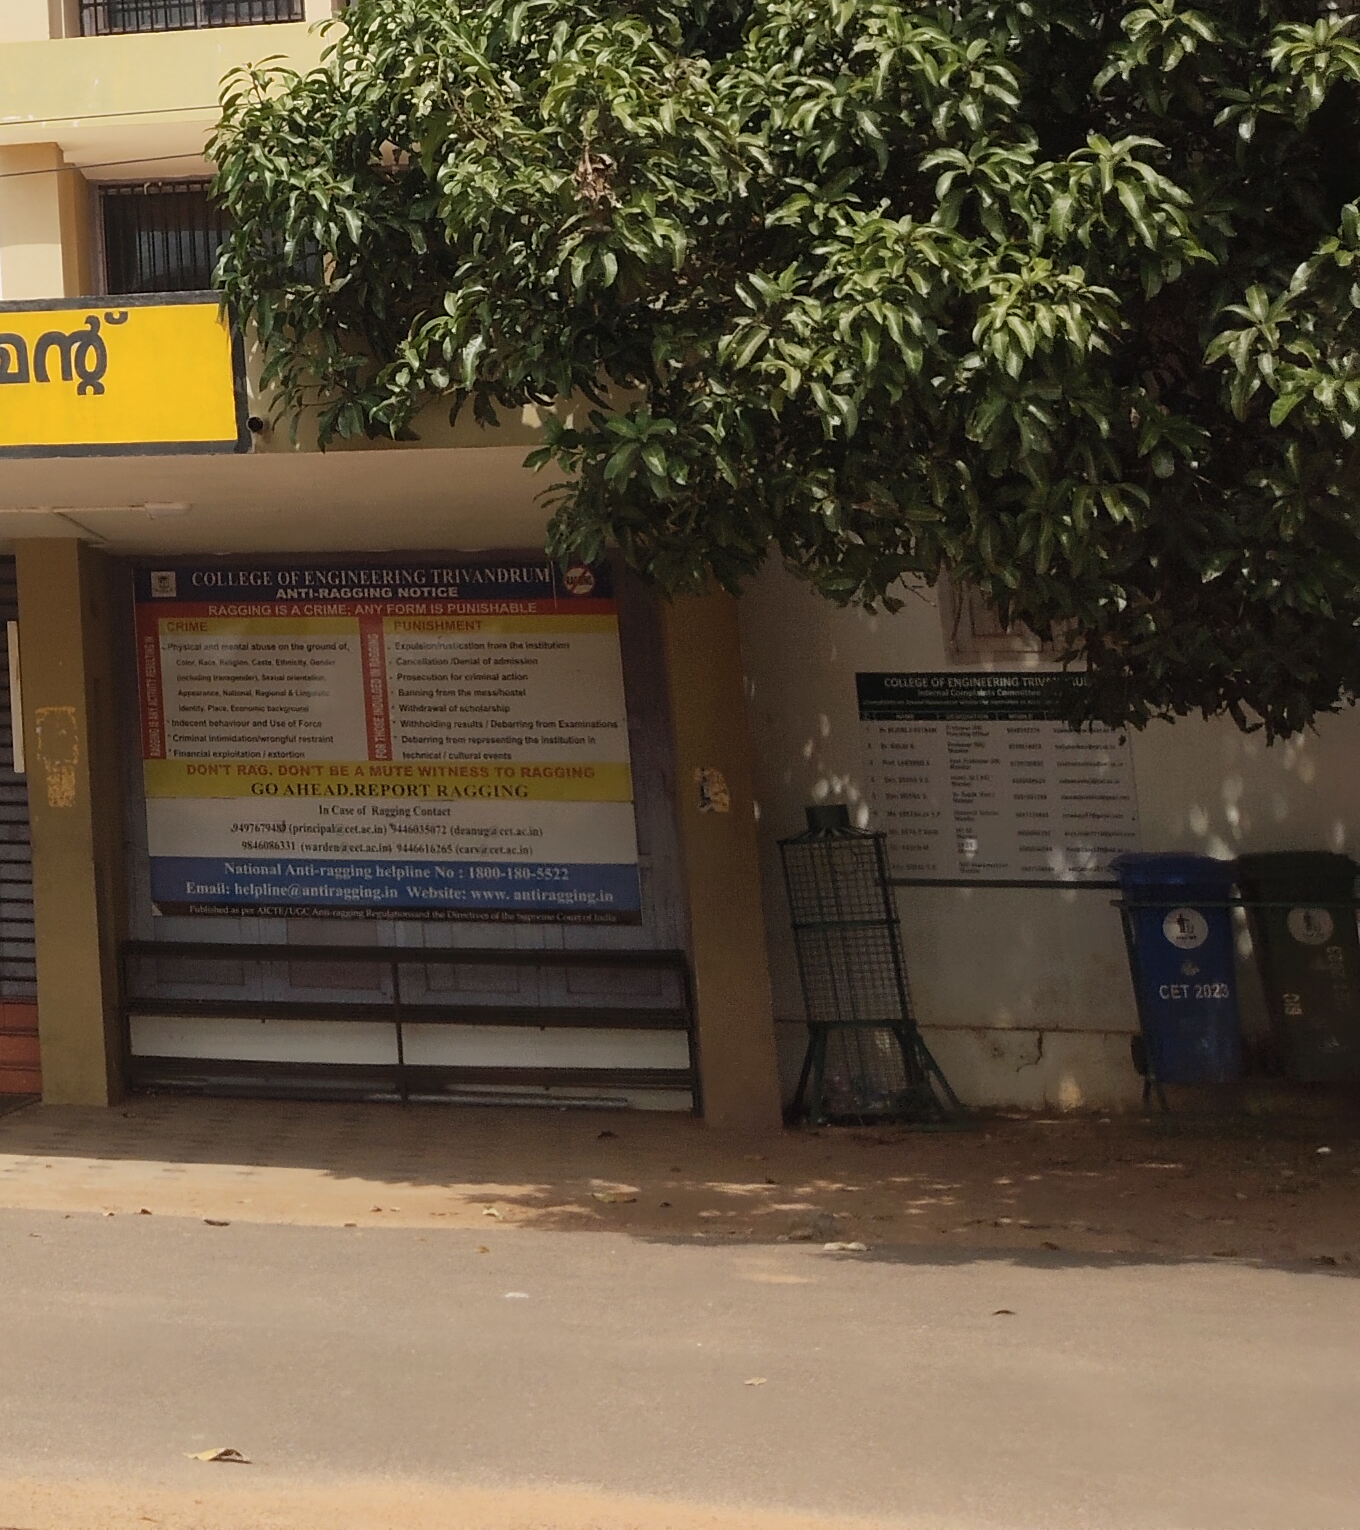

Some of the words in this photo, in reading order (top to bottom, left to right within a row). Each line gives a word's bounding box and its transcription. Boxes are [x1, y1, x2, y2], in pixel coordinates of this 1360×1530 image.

[192, 571, 273, 586] COLLEGE
[278, 571, 299, 585] OF
[306, 570, 426, 584] ENGINEERING
[430, 568, 551, 584] TRIVANDRUM
[276, 588, 393, 598] ANTI-RAGGING
[398, 587, 458, 598] NOTICE
[208, 605, 271, 616] RAGGING
[275, 605, 287, 615] IS
[291, 605, 301, 615] A
[355, 604, 383, 614] ANY
[387, 604, 426, 614] FORM
[430, 604, 443, 614] IS
[447, 602, 537, 614] PUNISHABLE
[166, 622, 207, 632] CRIME
[394, 621, 482, 631] PUNISHMENT
[168, 643, 201, 651] Physical
[221, 643, 249, 651] mental
[251, 643, 276, 651] abuse
[278, 643, 289, 651] on
[291, 643, 304, 651] the
[306, 643, 336, 651] ground
[487, 642, 507, 651] from
[509, 642, 523, 651] the
[396, 657, 449, 665] Cancellation
[483, 657, 491, 665] of
[493, 657, 538, 665] admission
[261, 674, 284, 682] Sexual
[397, 673, 448, 681] Prosecution
[450, 673, 462, 681] for
[465, 673, 499, 681] criminal
[502, 673, 528, 681] action
[884, 678, 929, 687] COLLEGE
[931, 678, 946, 687] OF
[948, 678, 1019, 687] ENGINEERING
[399, 689, 433, 698] Banning
[436, 689, 455, 698] from
[458, 689, 472, 698] the
[231, 705, 265, 713] Economic
[267, 705, 308, 713] background
[399, 704, 446, 713] Withdrawal
[449, 704, 457, 713] of
[460, 704, 510, 713] scholarship
[172, 720, 206, 728] Indecent
[209, 720, 250, 728] behaviour
[252, 720, 267, 728] and
[270, 720, 285, 728] Use
[288, 720, 296, 728] of
[298, 720, 321, 728] Force
[400, 720, 451, 729] Withholding
[454, 720, 483, 729] results
[490, 720, 533, 729] Debarring
[536, 720, 556, 729] from
[558, 720, 618, 729] Examinations
[173, 734, 206, 744] Criminal
[298, 734, 333, 744] restraint
[401, 736, 443, 745] Debarring
[446, 736, 465, 745] from
[468, 736, 522, 745] representing
[525, 736, 539, 745] the
[174, 750, 210, 758] Financial
[213, 750, 261, 758] exploitation
[268, 750, 305, 758] extortion
[449, 752, 481, 760] cultural
[483, 752, 511, 760] events
[187, 764, 231, 776] DON'T
[278, 765, 324, 776] DON'T
[329, 766, 349, 776] BE
[355, 766, 365, 776] A
[369, 766, 413, 777] MUTE
[418, 766, 489, 778] WITNESS
[494, 767, 515, 778] TO
[521, 767, 595, 779] RAGGING
[251, 782, 279, 796] GO
[437, 785, 529, 798] RAGGING
[319, 805, 329, 815] In
[332, 805, 354, 815] Case
[357, 805, 366, 815] of
[371, 805, 411, 817] Ragging
[413, 806, 451, 816] Contact
[224, 862, 282, 875] National
[285, 864, 372, 879] Anti-ragging
[376, 865, 431, 881] helpline
[434, 866, 454, 878] No
[469, 867, 570, 881] 1800-180-5522
[186, 882, 230, 895] Email:
[234, 883, 398, 901] helpline@antiragging.in
[406, 886, 466, 899] Website:
[471, 890, 509, 900] www.
[514, 889, 613, 903] antiragging.in
[1159, 984, 1189, 999] CET
